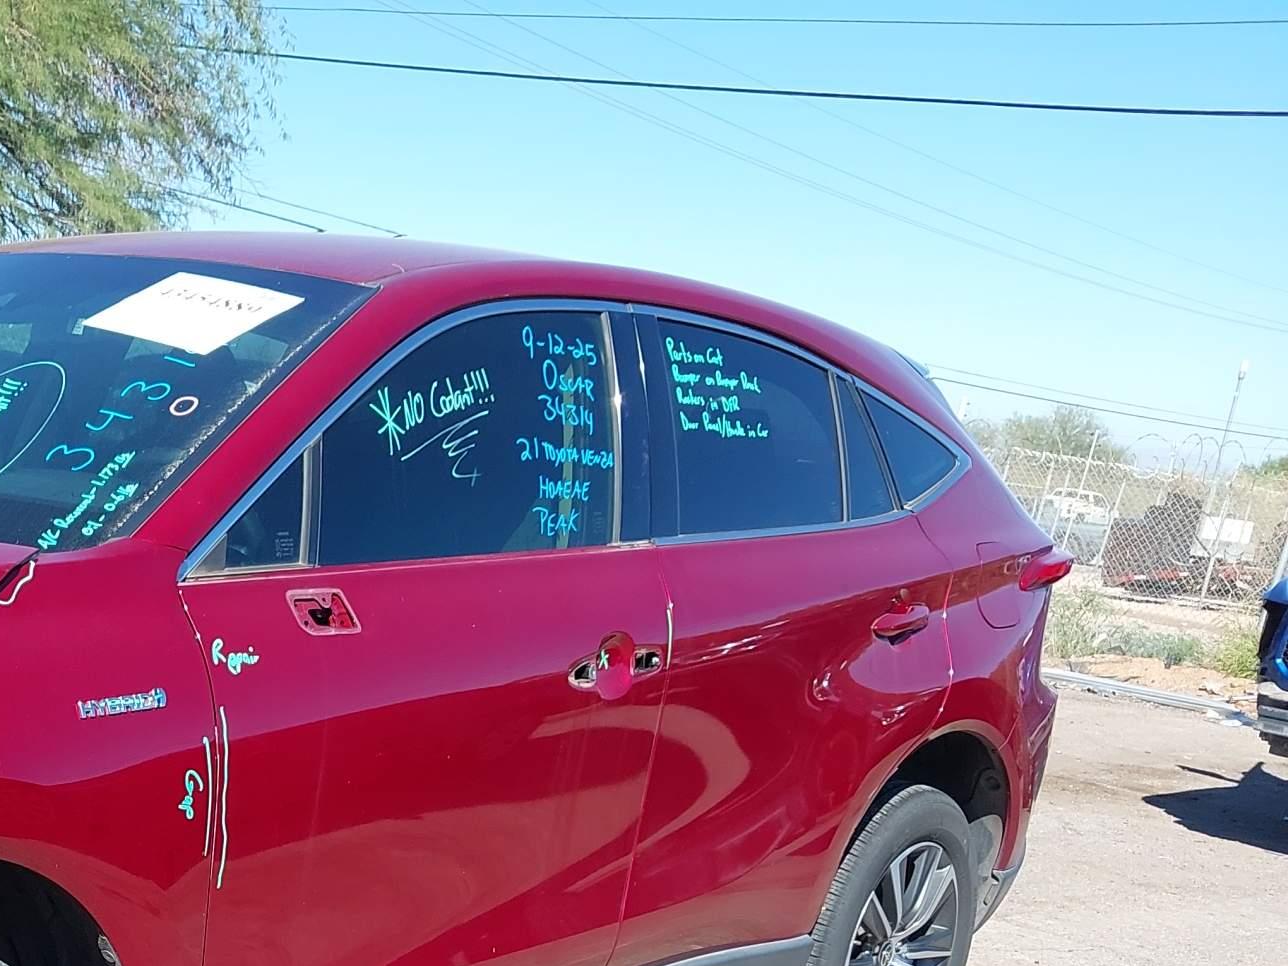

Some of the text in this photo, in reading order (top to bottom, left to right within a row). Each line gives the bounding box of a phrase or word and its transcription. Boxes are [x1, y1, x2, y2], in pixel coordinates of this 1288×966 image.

[522, 326, 596, 365] 9-12-25
[666, 337, 692, 363] Parts
[694, 354, 704, 363] on
[538, 395, 593, 435] 34314
[516, 438, 538, 461] 21
[532, 507, 580, 536] PEAK
